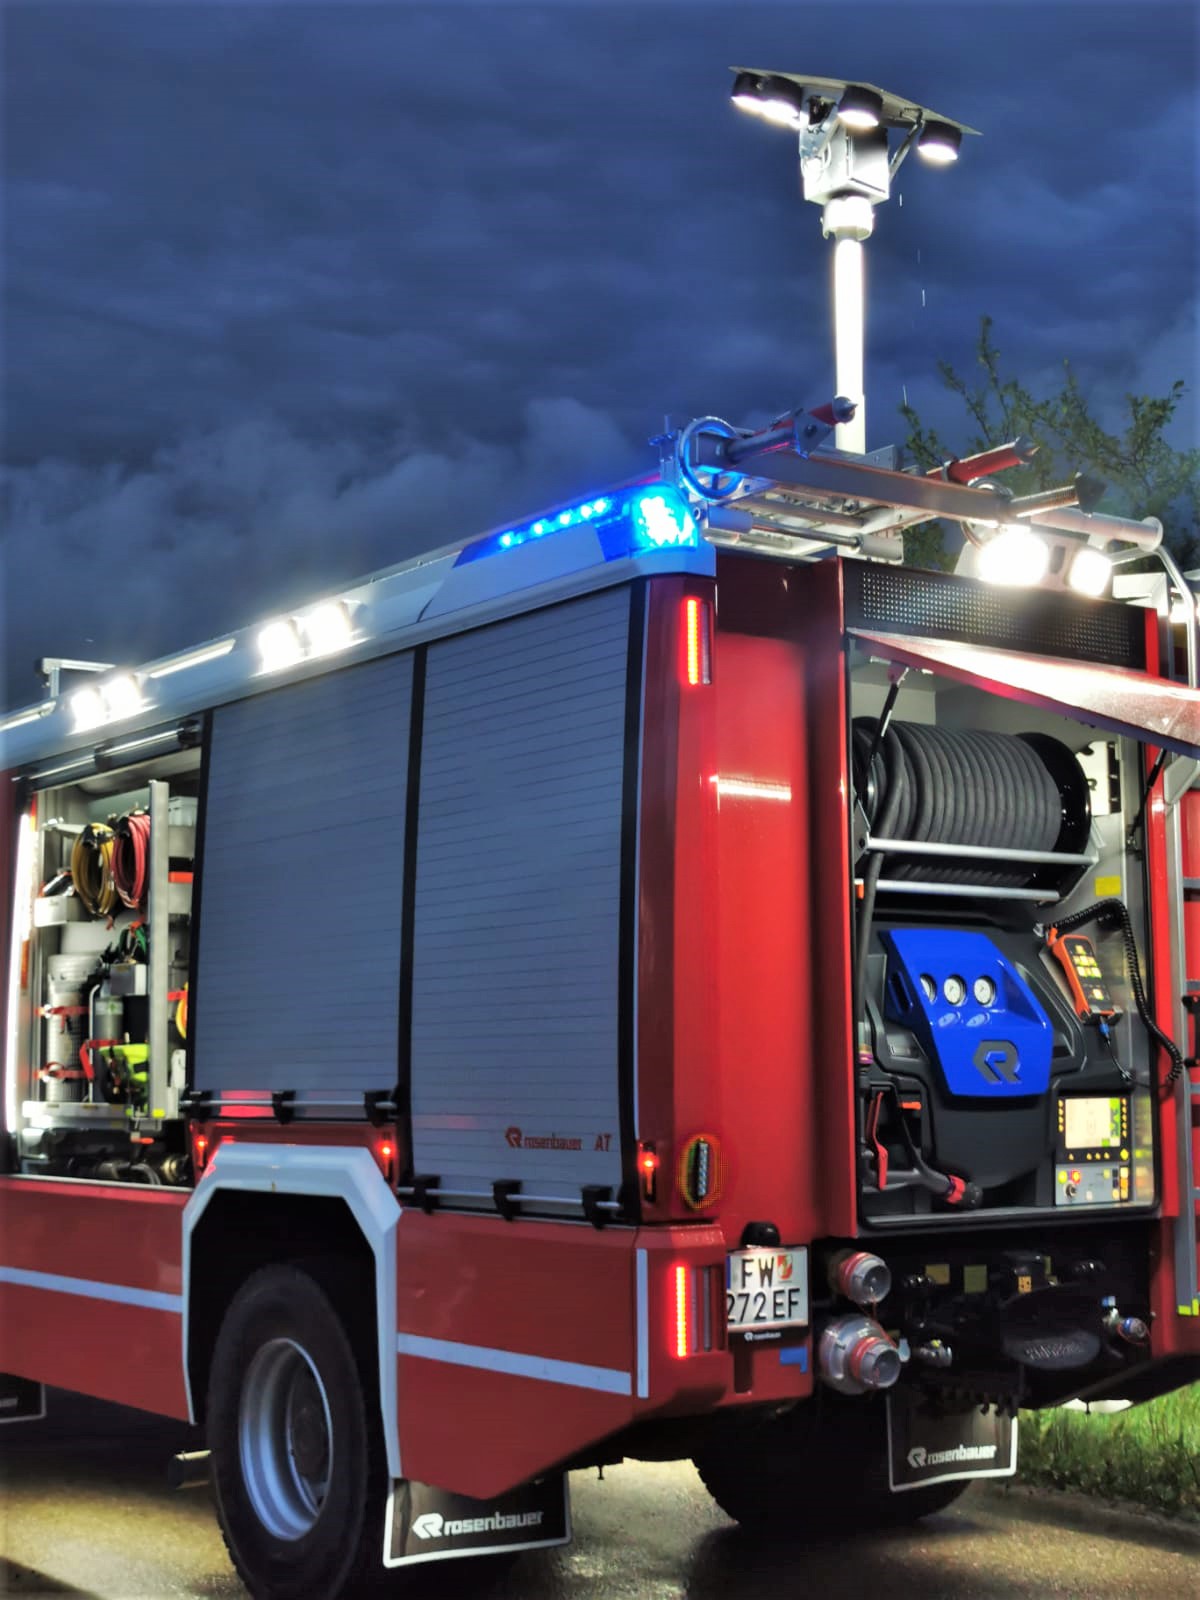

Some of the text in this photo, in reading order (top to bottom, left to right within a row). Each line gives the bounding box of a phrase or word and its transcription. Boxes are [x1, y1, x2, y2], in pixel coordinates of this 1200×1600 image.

[524, 1132, 582, 1151] rosenbauer
[594, 1133, 612, 1152] AT
[742, 1256, 774, 1289] FW
[727, 1288, 801, 1322] 272EF
[928, 1444, 997, 1465] rosenbauer
[444, 1511, 544, 1536] rosenbauer
